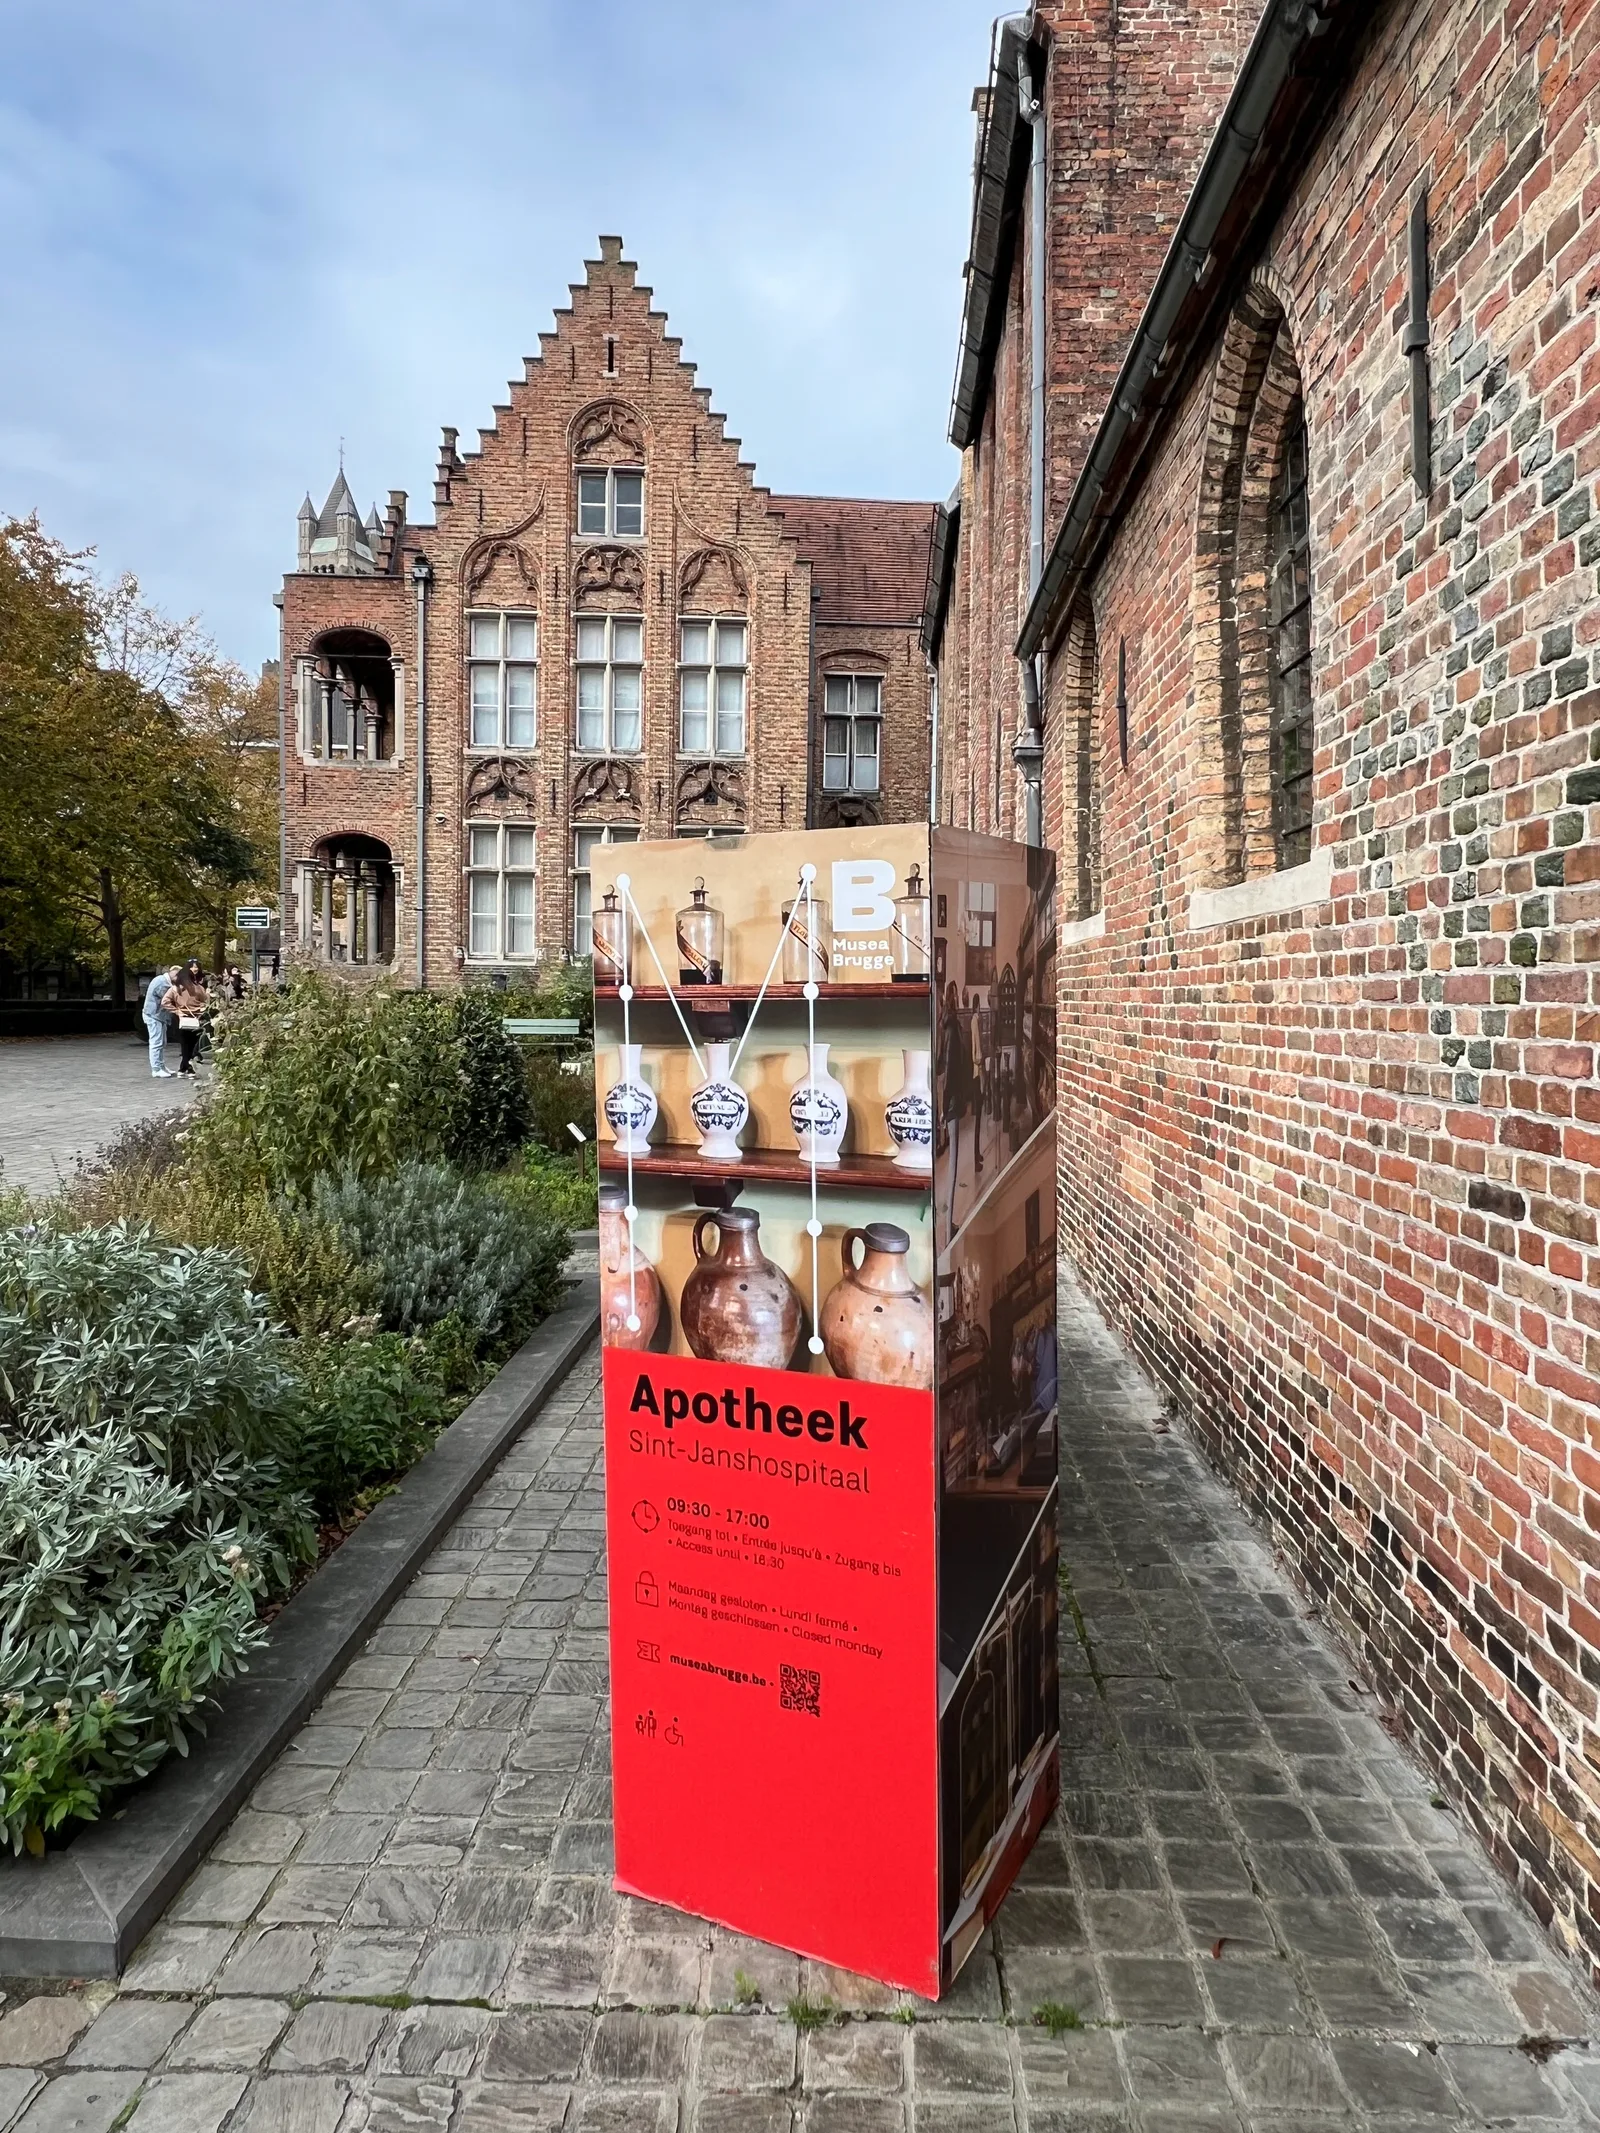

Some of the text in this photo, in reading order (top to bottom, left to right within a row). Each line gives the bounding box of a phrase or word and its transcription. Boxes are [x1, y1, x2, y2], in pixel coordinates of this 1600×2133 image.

[832, 859, 896, 932] B
[832, 938, 889, 952] Musea
[832, 953, 895, 970] Brugge
[629, 1374, 869, 1449] Apotheek
[629, 1430, 870, 1493] Sint-Janshospitaal
[667, 1497, 711, 1518] 09:30
[726, 1508, 770, 1529] 17:00
[667, 1518, 712, 1541] Toegang
[715, 1529, 730, 1541] tot
[742, 1533, 777, 1551] Entrée
[835, 1552, 880, 1576] Zugang
[883, 1561, 902, 1576] bis
[676, 1537, 713, 1554] Access
[716, 1547, 741, 1561] until
[668, 1580, 849, 1632] Maandag gesloten Lundi fermé
[668, 1596, 883, 1660] Montag geschlossen Closed monday
[669, 1654, 767, 1687] museabrugge.be
